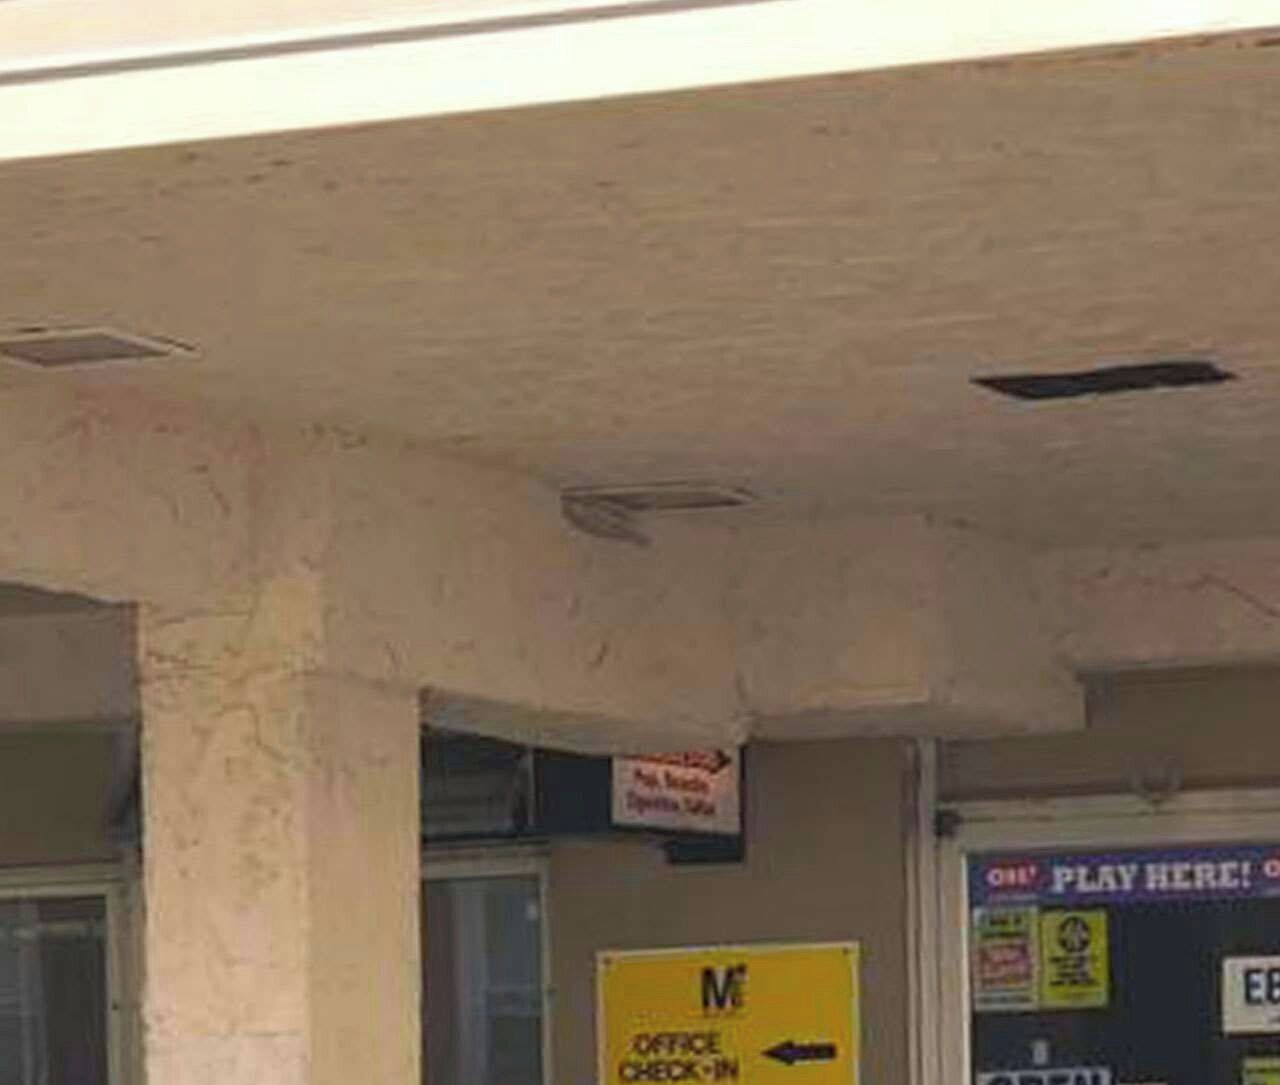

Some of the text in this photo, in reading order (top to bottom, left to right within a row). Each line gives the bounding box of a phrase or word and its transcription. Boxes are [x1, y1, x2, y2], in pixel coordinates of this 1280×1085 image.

[1052, 864, 1137, 893] PLAY
[1144, 860, 1252, 891] HERE!
[631, 1032, 720, 1054] OFFICE
